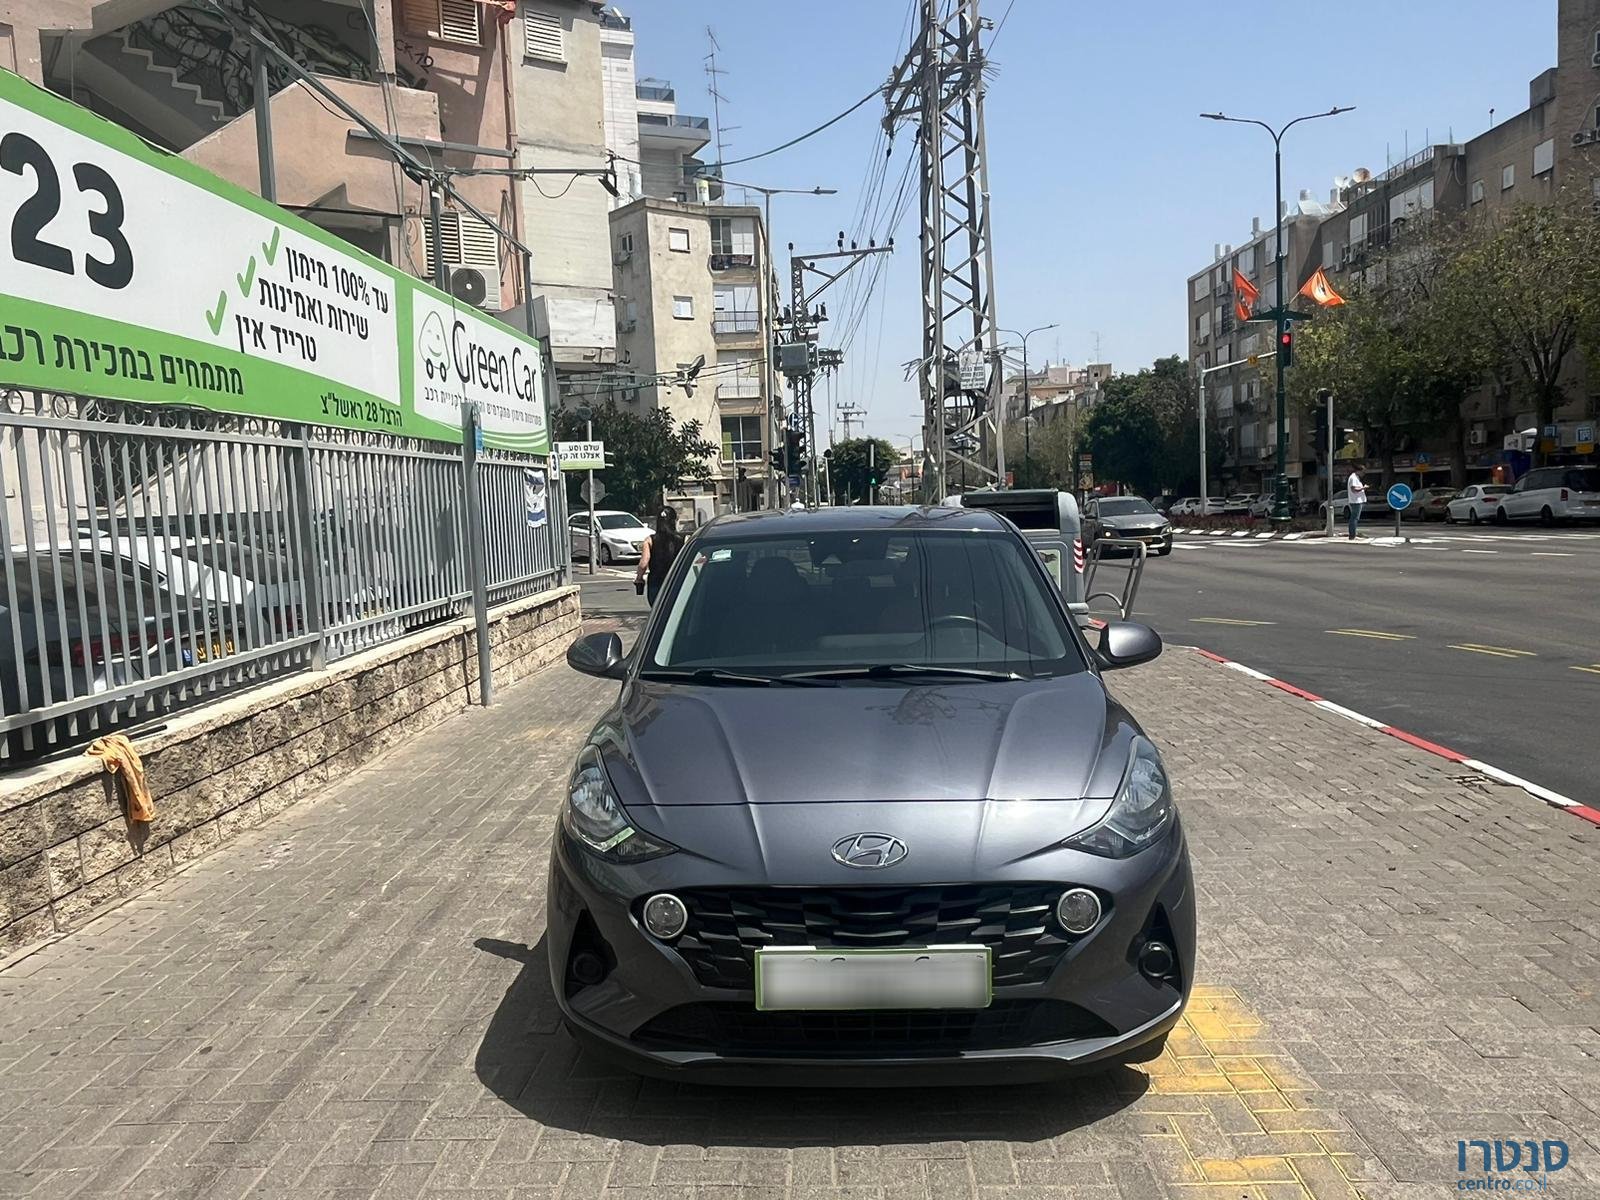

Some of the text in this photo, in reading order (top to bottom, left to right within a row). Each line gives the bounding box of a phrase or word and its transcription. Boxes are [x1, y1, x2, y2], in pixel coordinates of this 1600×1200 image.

[0, 132, 134, 290] 23
[285, 246, 388, 314] עד 100% מימון
[258, 277, 369, 340] שירות ואמינות
[53, 333, 155, 382] במכירת
[235, 313, 317, 362] טרייד אין
[452, 320, 537, 403] Green Car
[160, 354, 244, 395] מתמחים
[320, 392, 403, 427] הרצל 28 ראשל"צ
[580, 452, 601, 460] אצלנו
[583, 444, 600, 452] שלם
